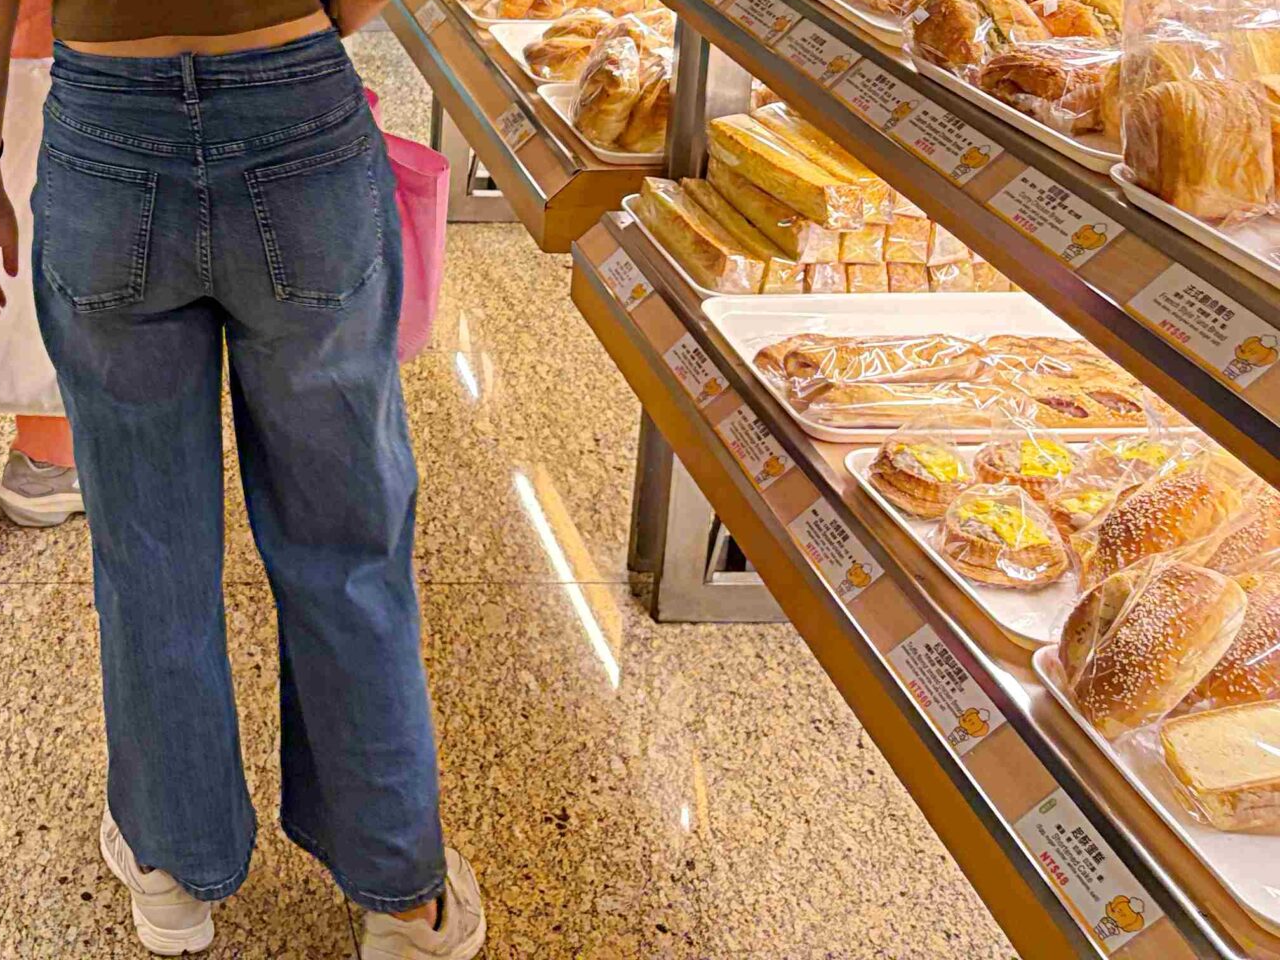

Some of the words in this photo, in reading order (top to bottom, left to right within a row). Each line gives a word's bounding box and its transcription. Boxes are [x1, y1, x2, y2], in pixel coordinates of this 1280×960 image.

[1159, 292, 1181, 309] French
[1178, 306, 1195, 321] Style
[1193, 315, 1209, 329] Tuna
[1207, 324, 1228, 342] Bread
[1051, 832, 1079, 866] Shortened
[1077, 863, 1094, 884] Cake
[1072, 827, 1106, 865] 起酥蛋糕
[1039, 851, 1070, 886] NT$48
